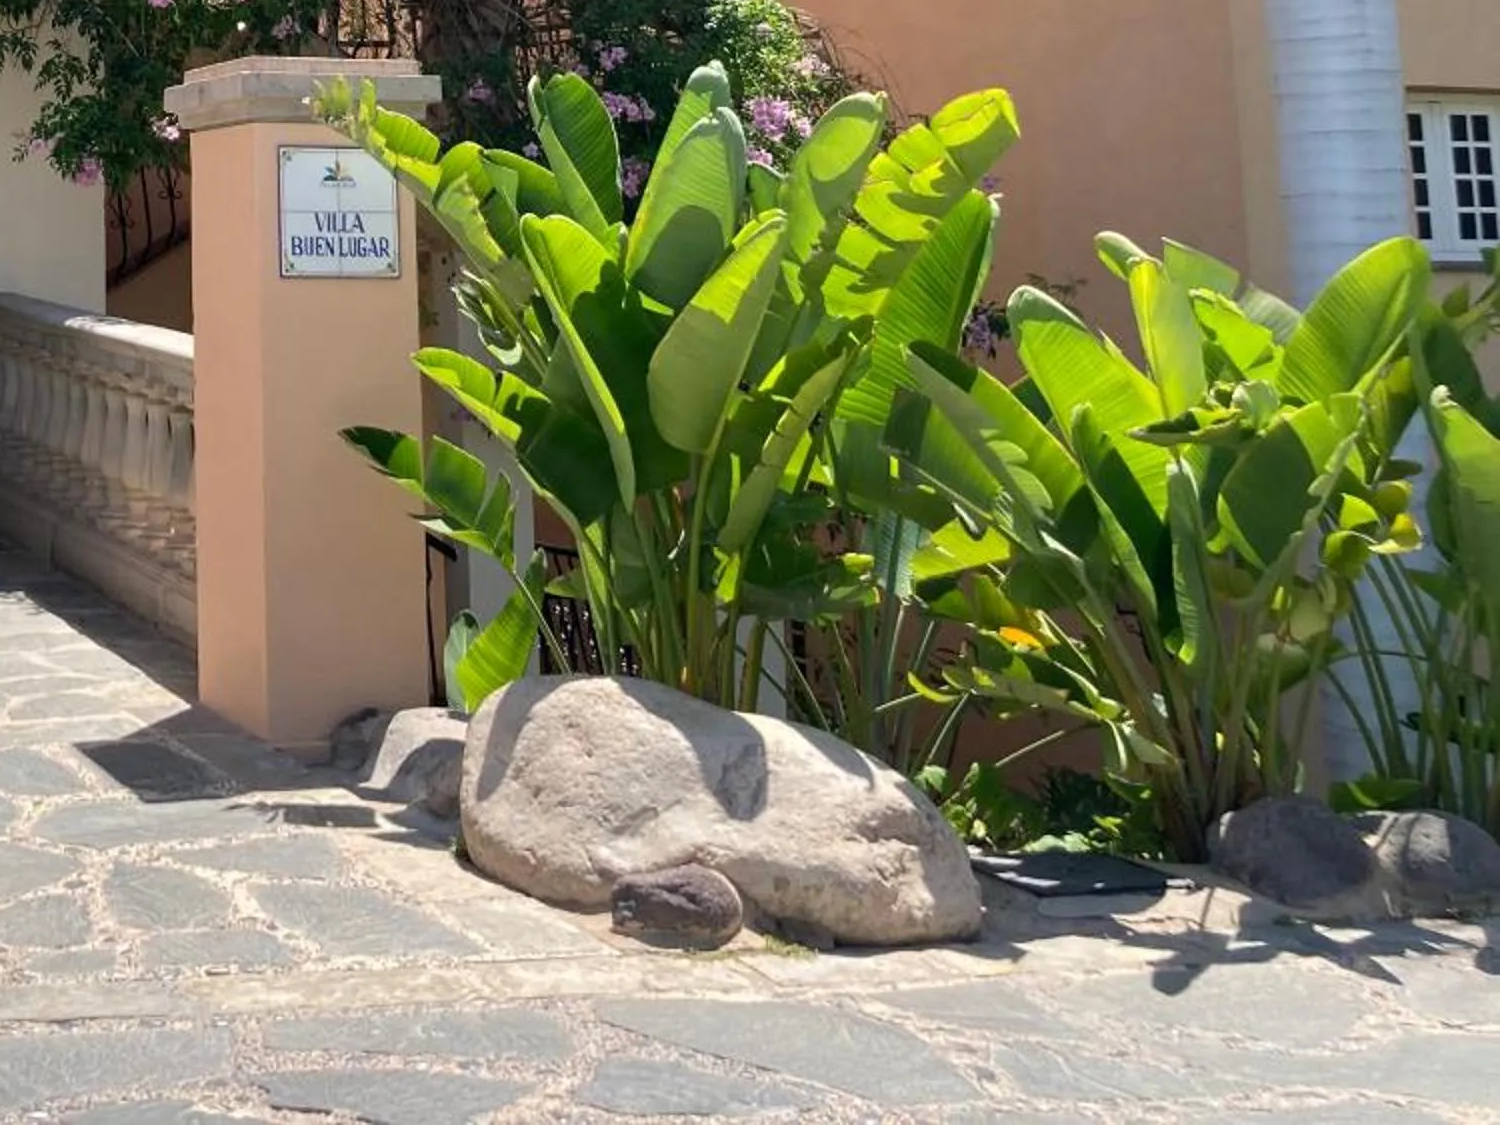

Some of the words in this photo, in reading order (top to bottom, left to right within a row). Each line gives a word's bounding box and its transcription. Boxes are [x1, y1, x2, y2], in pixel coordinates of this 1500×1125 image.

[314, 211, 365, 233] VILLA
[291, 236, 335, 257] BUEN
[339, 236, 390, 258] LUGAR
